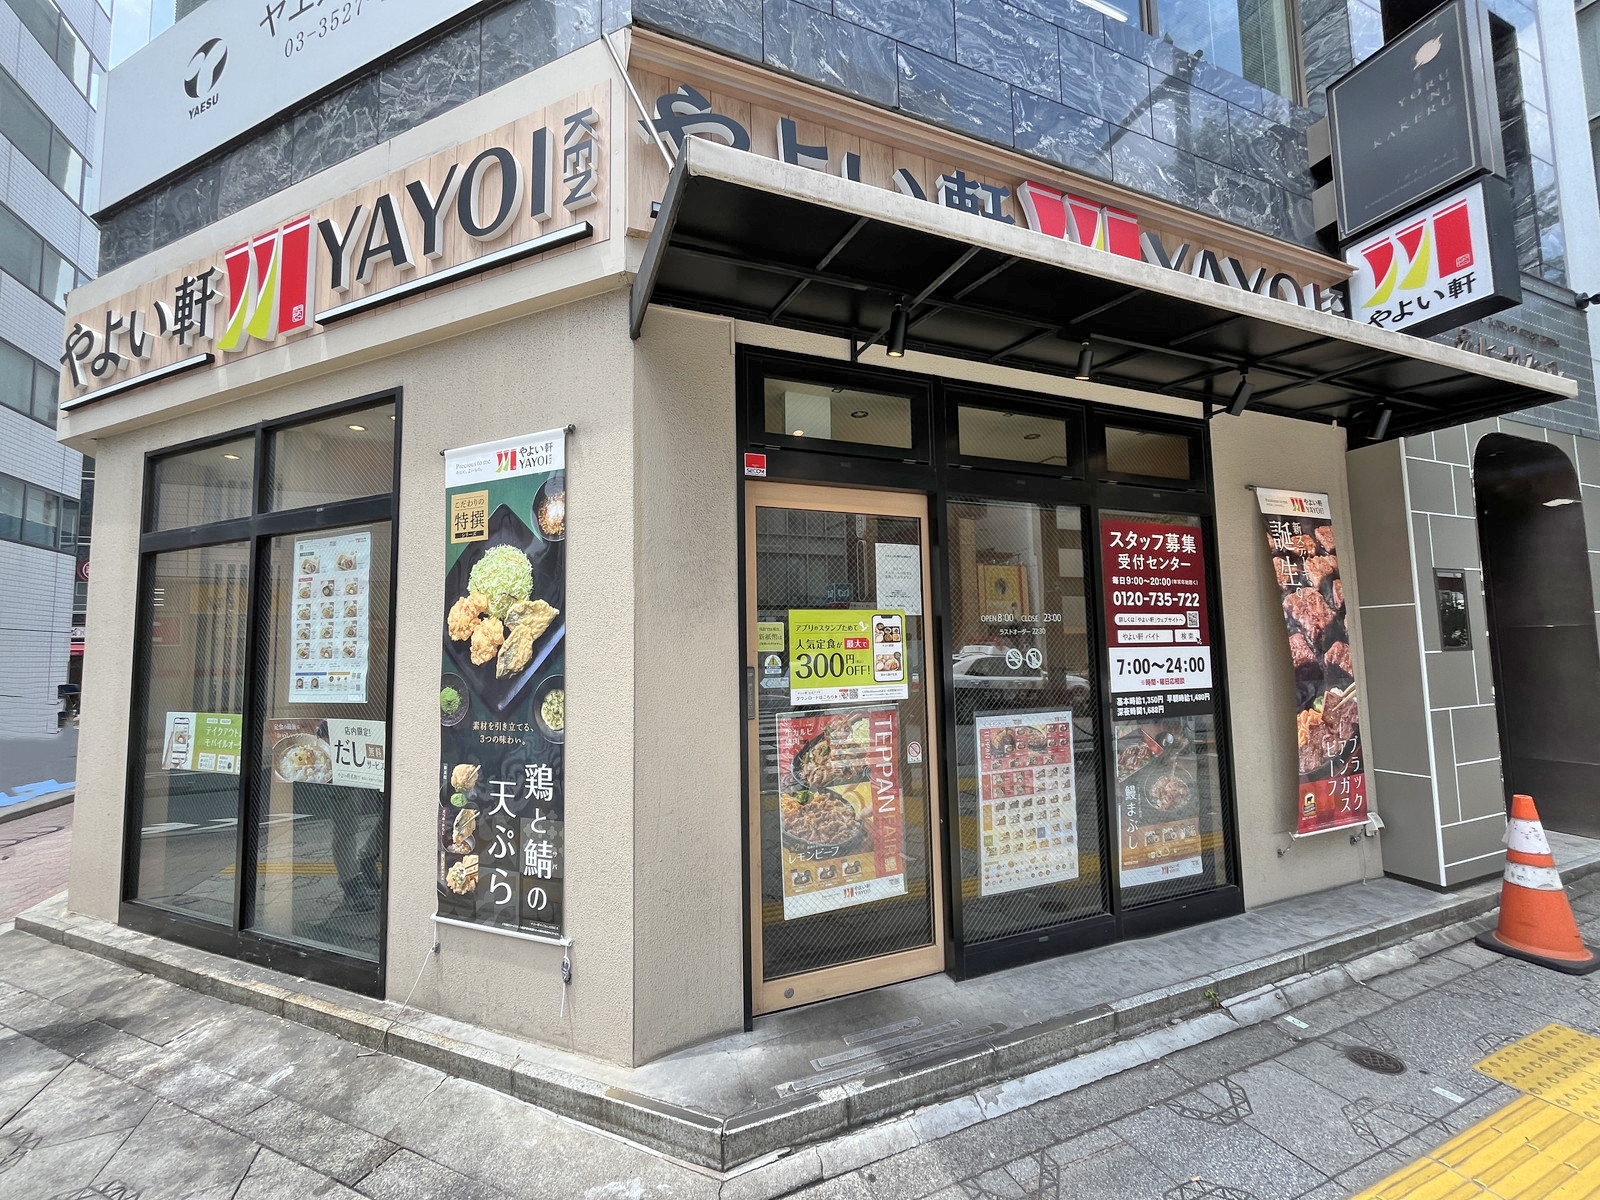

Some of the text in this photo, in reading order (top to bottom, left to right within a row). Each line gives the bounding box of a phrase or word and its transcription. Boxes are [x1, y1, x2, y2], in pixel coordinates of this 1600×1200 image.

[260, 0, 327, 37] ヤエ
[285, 0, 372, 58] 03-3527
[188, 93, 219, 119] YAESU
[1373, 93, 1452, 149] KAKERU
[564, 106, 599, 213] KEN
[318, 126, 553, 293] YAYOI
[1367, 271, 1476, 328] やよい軒
[59, 266, 224, 391] やよい軒
[519, 442, 553, 458] やよい軒
[519, 455, 548, 469] YAYOI
[455, 498, 485, 508] こだわりの
[454, 509, 485, 531] 特撰
[1110, 530, 1197, 554] スタッフ募集
[1118, 553, 1191, 571] 受付センター
[1269, 520, 1303, 598] 誕生。
[1113, 591, 1200, 607] 0120-735-722
[795, 624, 859, 632] アプリのスタンプためて
[998, 613, 1014, 622] 8:00
[1044, 613, 1062, 622] 23:00
[795, 639, 843, 650] 人気定食が
[846, 639, 868, 649] 最大で
[1122, 632, 1160, 640] やよい軒 バイト
[1181, 632, 1194, 640] 検索
[795, 652, 845, 679] 300
[845, 654, 855, 664] 円
[846, 665, 871, 676] OFF!
[344, 726, 372, 737] 店内限定!
[472, 721, 535, 733] 素材を引き立てる、
[479, 734, 527, 746] 3つの味わい。
[334, 739, 366, 768] だし
[873, 715, 896, 813] TEPPAN
[1338, 740, 1352, 813] アンガス
[1350, 735, 1363, 811] ブラック
[488, 780, 518, 906] 天ぷら
[523, 763, 555, 911] 鶏と鯖の
[788, 845, 840, 865] レモンビーフ
